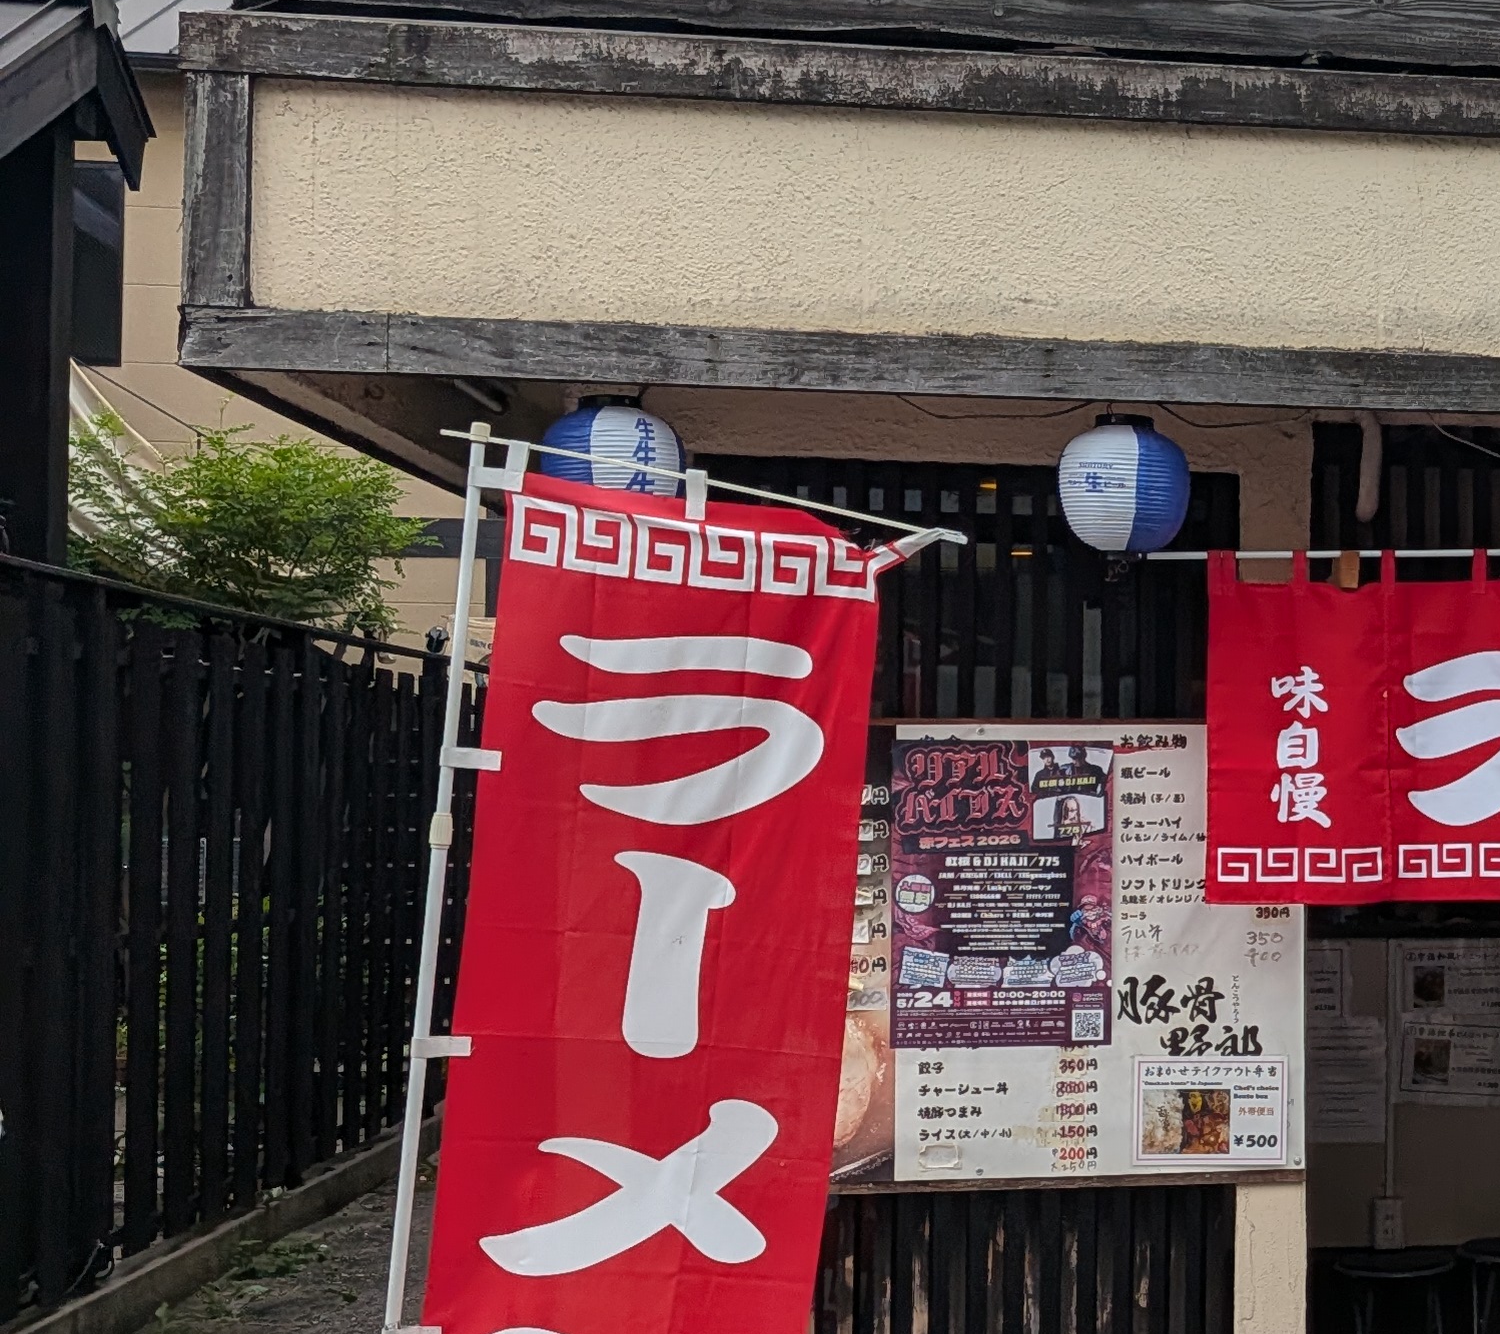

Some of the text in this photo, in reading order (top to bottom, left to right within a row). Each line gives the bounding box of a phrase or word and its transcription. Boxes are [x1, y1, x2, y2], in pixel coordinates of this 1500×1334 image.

[1120, 734, 1187, 749] お飲み物
[1269, 666, 1331, 829] 味自慢
[1120, 767, 1171, 779] 瓶ビール
[1121, 817, 1182, 829] チューハイ
[983, 857, 997, 866] DJ
[1120, 854, 1183, 866] ハイボール
[1121, 912, 1147, 920] コーラ
[1117, 974, 1225, 1024] 豚骨
[918, 1061, 944, 1075] 餃子
[918, 1082, 1008, 1096] チャーシュー丼
[1233, 1135, 1278, 1148] ¥500
